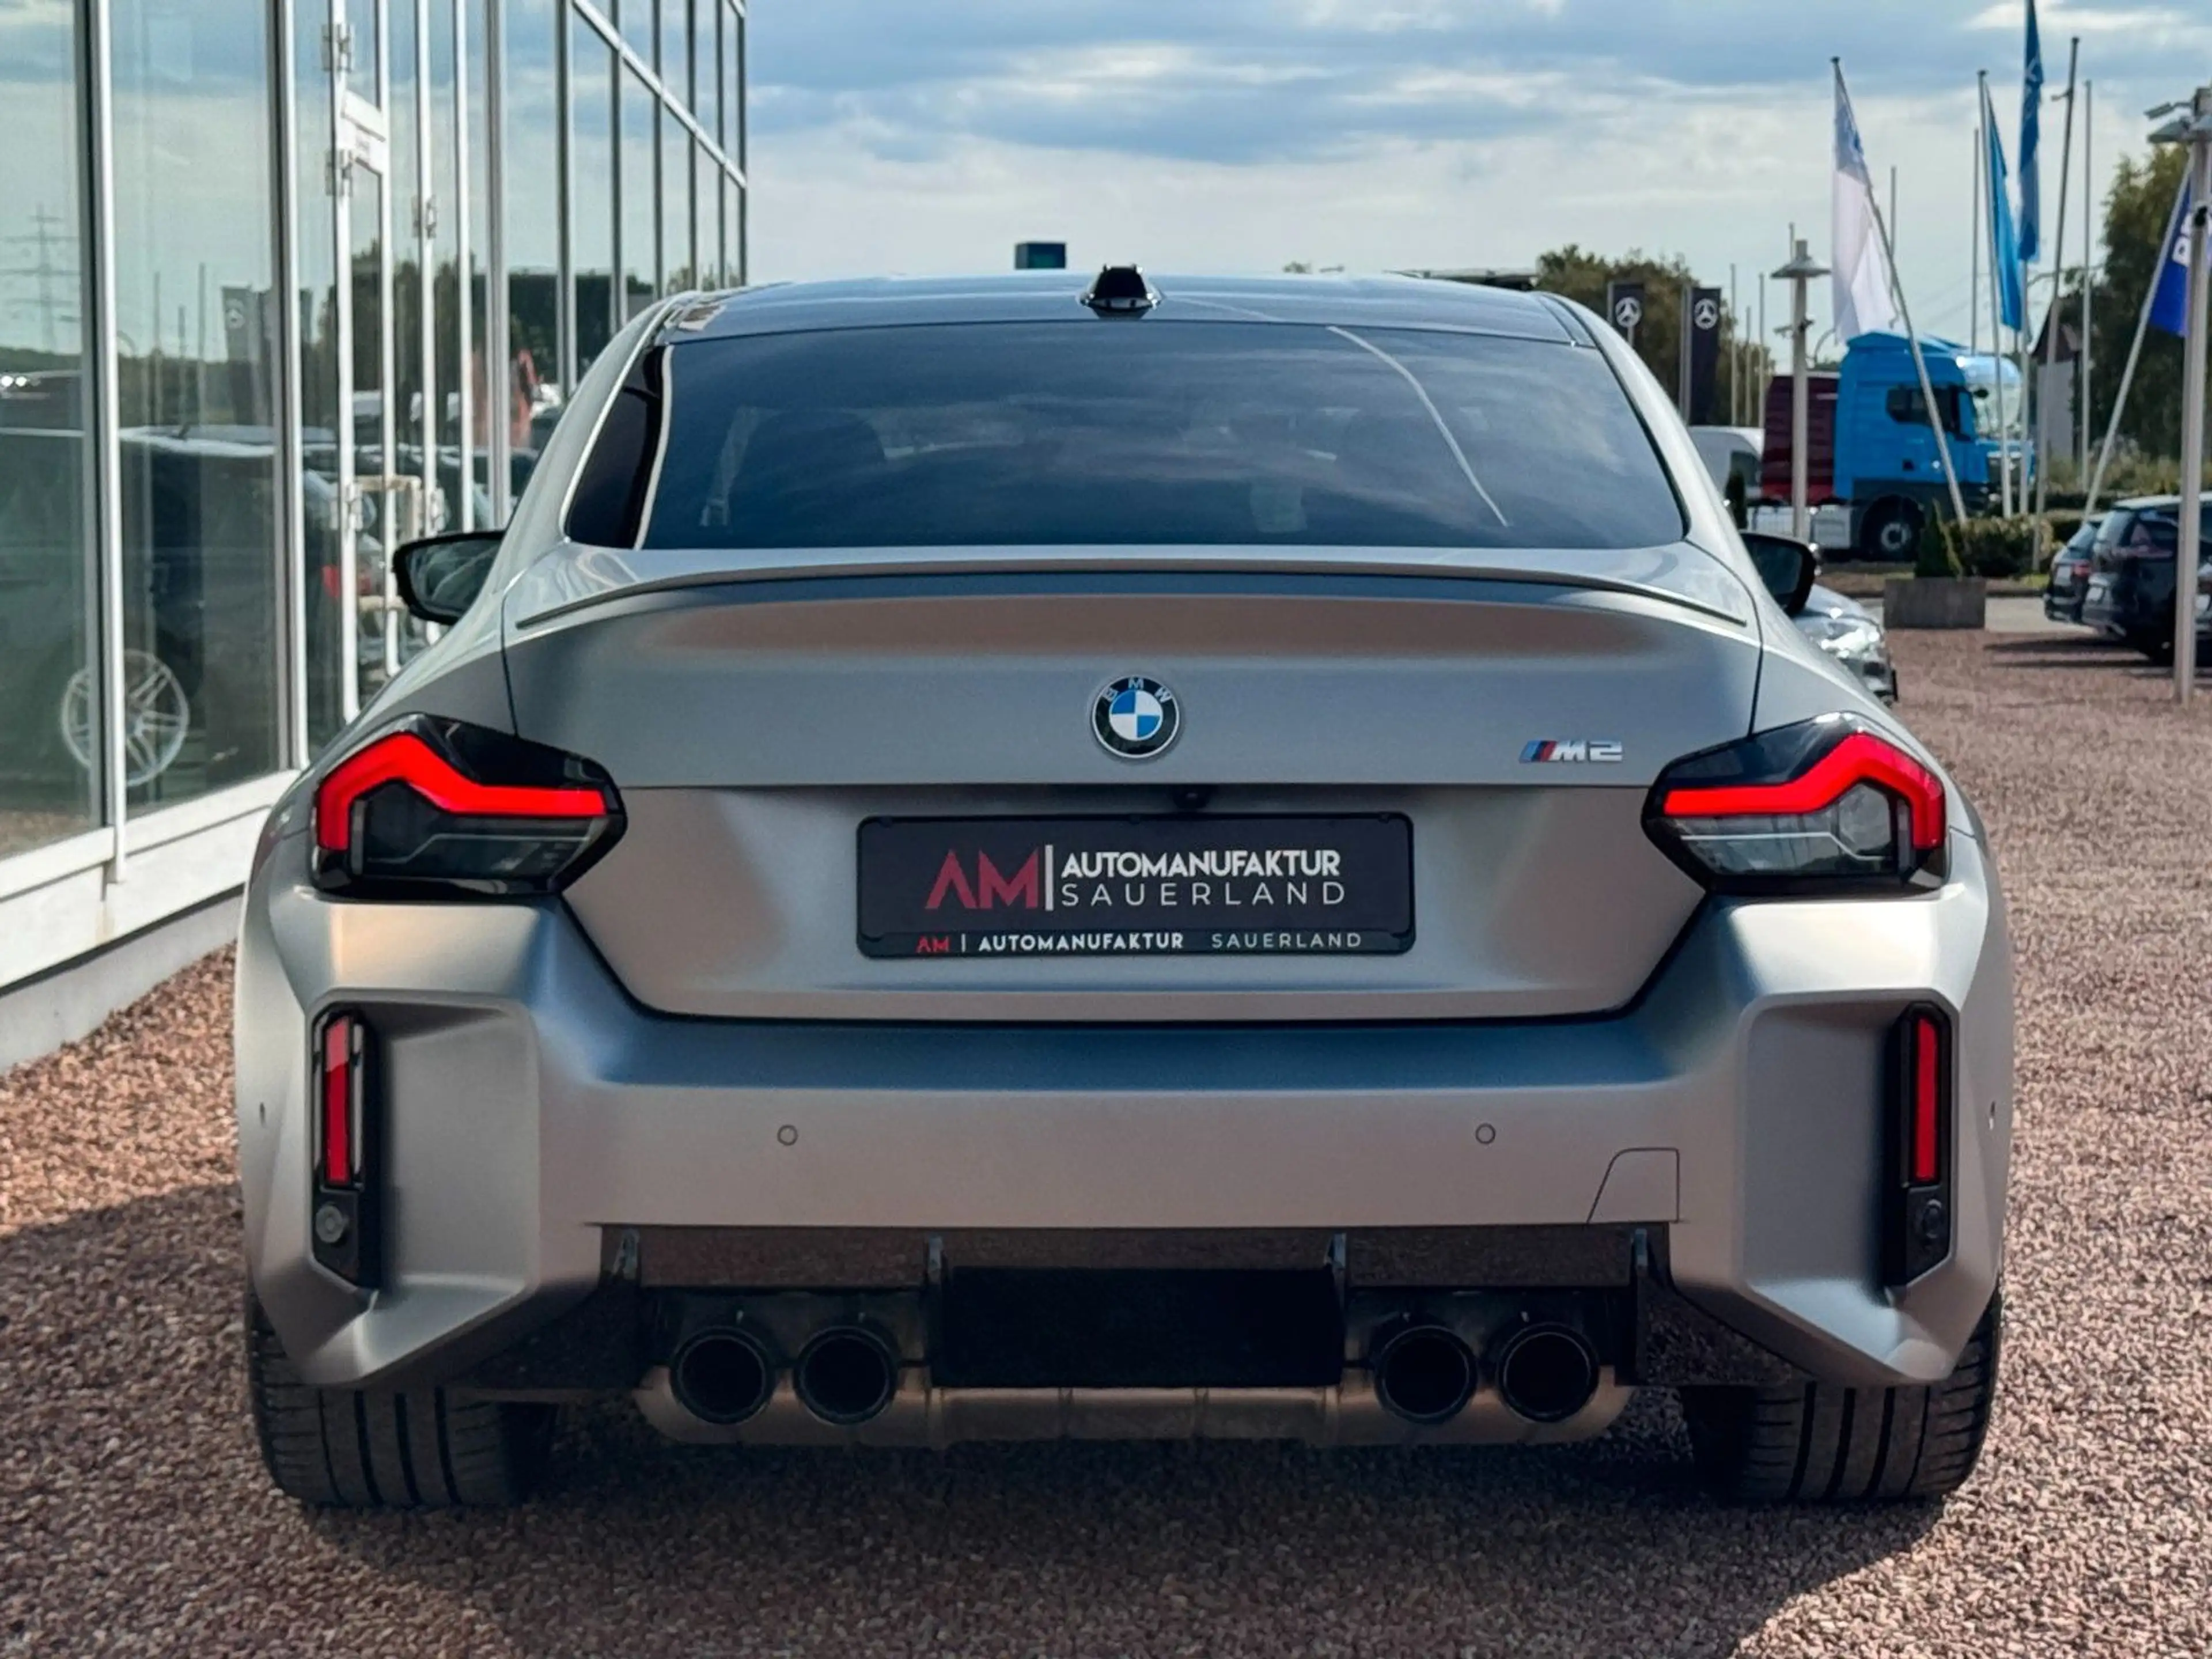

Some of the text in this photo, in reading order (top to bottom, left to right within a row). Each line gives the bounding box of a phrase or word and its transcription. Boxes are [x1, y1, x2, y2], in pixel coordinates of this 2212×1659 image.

[1103, 677, 1173, 703] BMW
[1548, 740, 1623, 762] M2
[1061, 850, 1341, 878] AUTOMANUFAKTUR
[925, 849, 1038, 909] AM
[1062, 881, 1345, 907] SAUERLAND
[916, 932, 1361, 952] AM AUTOMANUFAKTUR SAUERLAND
